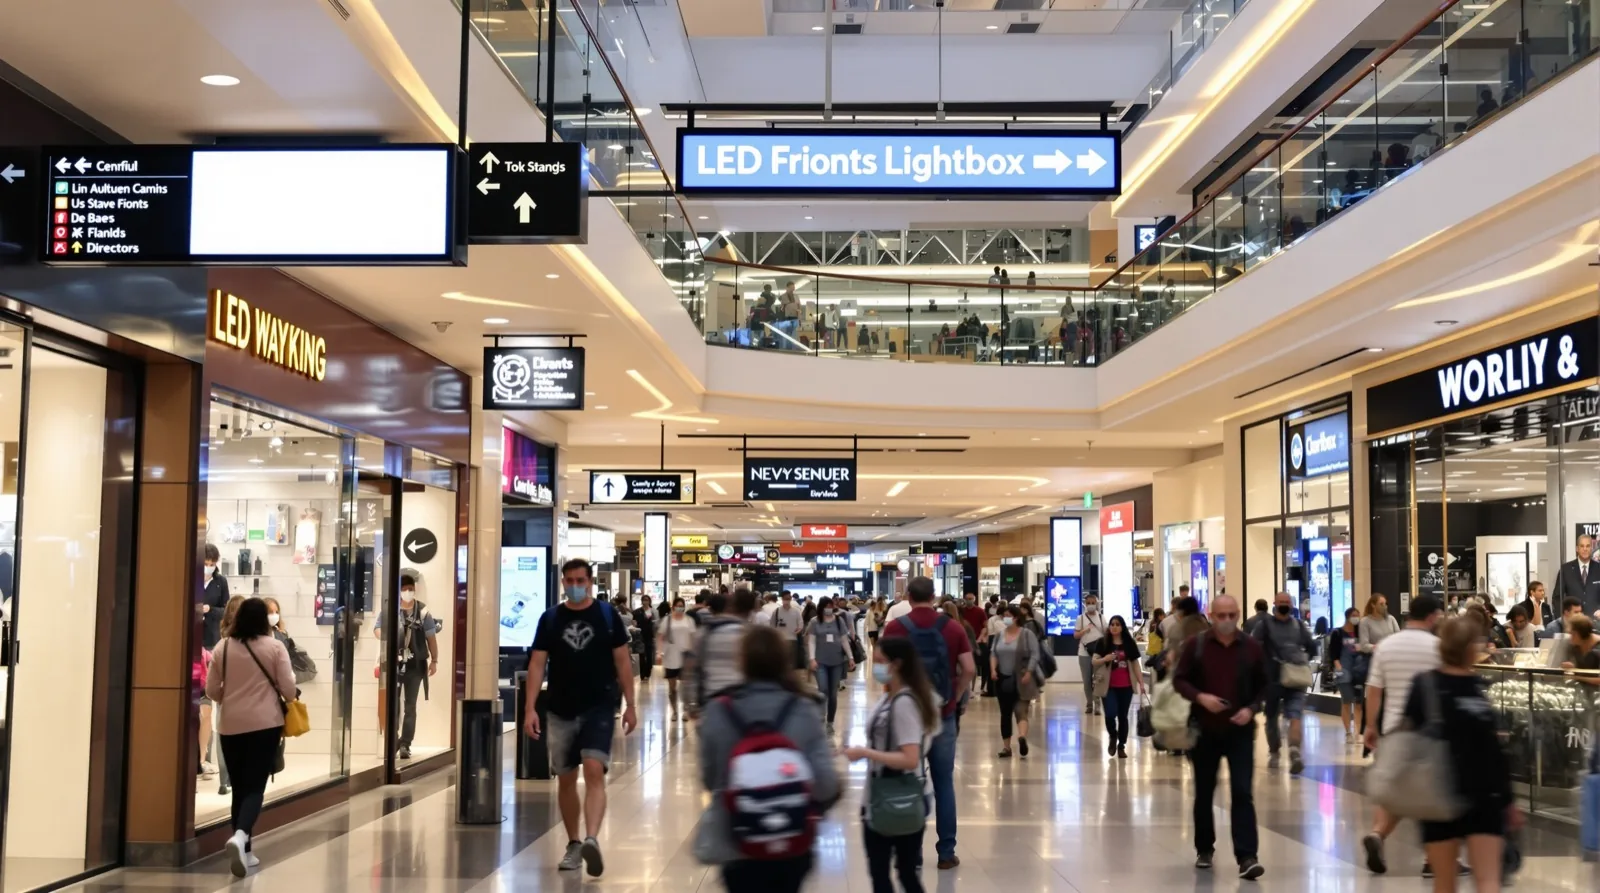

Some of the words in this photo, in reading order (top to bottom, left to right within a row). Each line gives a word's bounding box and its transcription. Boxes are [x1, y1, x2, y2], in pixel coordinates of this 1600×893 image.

[504, 161, 525, 173] Tok
[527, 161, 566, 175] Stangs
[697, 145, 762, 175] LED
[771, 144, 877, 175] Frionts
[884, 144, 1025, 182] Lightbox
[72, 183, 88, 194] Lin
[71, 198, 85, 209] Us
[71, 212, 86, 223] De
[87, 212, 115, 223] Baes
[86, 242, 139, 253] Directors
[214, 289, 251, 349] LED
[255, 307, 327, 381] WAYKING
[1437, 337, 1549, 409] WORLIY
[1557, 334, 1580, 379] &
[751, 467, 792, 481] NEVY
[794, 467, 850, 481] SENUER
